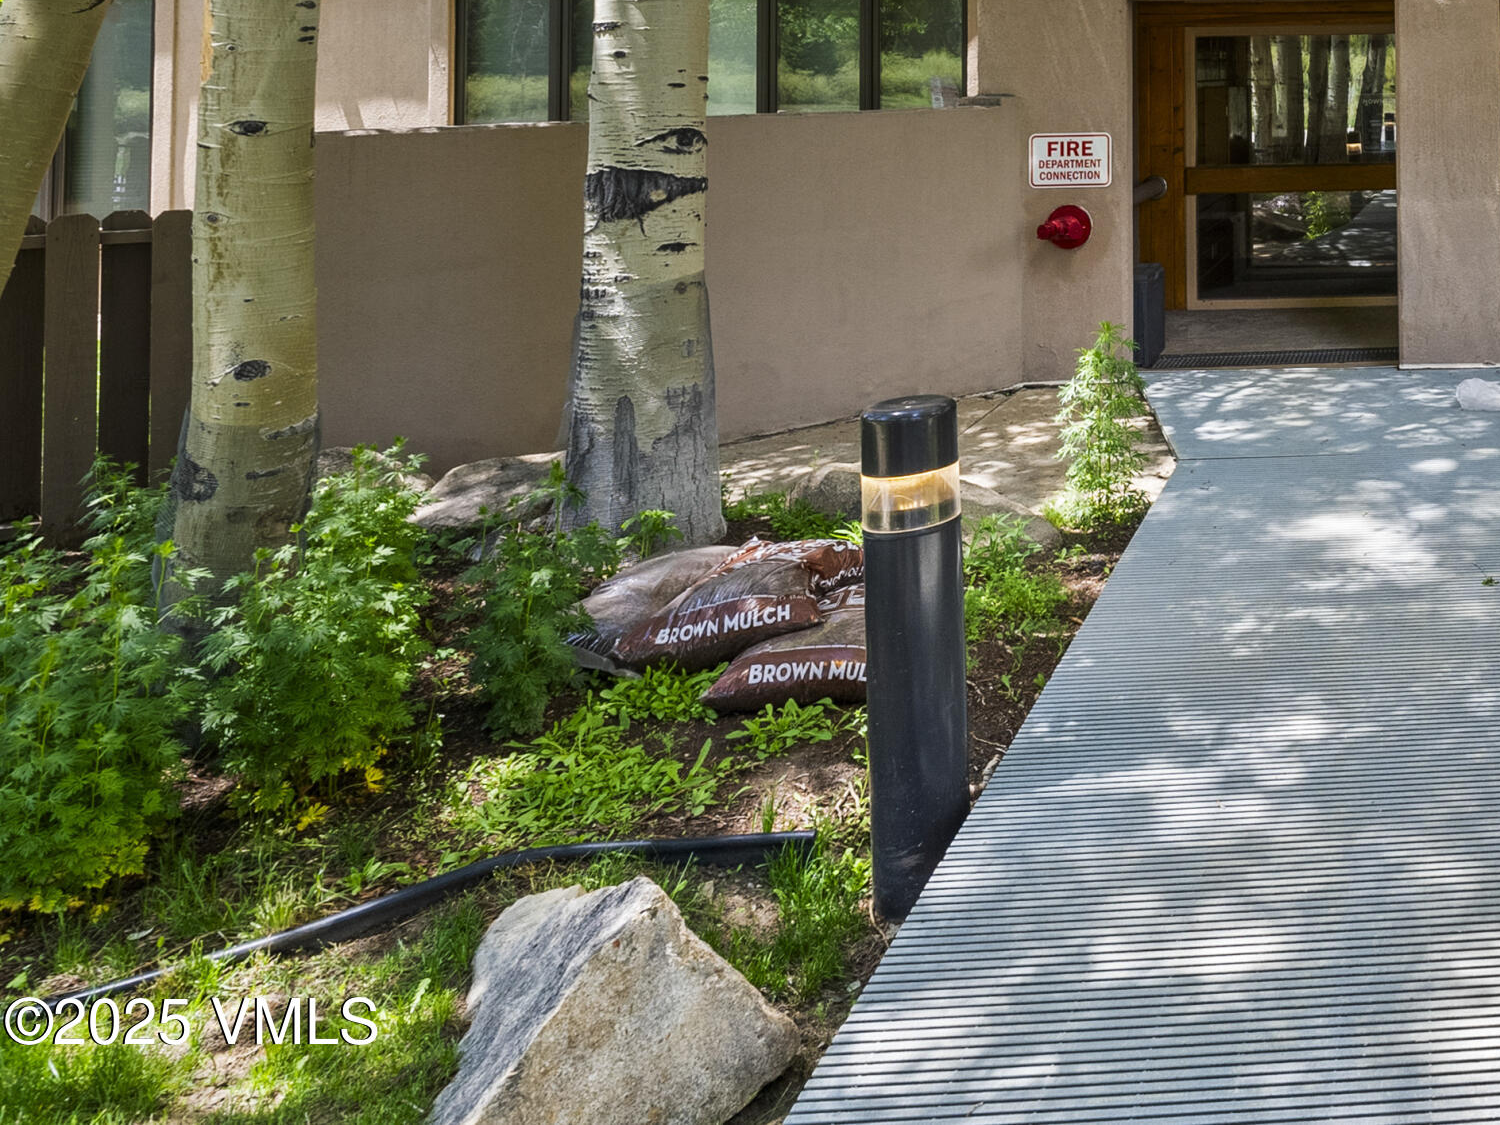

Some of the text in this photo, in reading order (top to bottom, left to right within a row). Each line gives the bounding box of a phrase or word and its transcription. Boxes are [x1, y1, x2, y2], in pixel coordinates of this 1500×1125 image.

[1047, 140, 1093, 157] FIRE
[1038, 159, 1101, 169] DEPARTMENT
[1039, 171, 1100, 181] CONNECTION
[654, 604, 790, 645] BROWN MULCH
[748, 661, 866, 684] BROWN MUL
